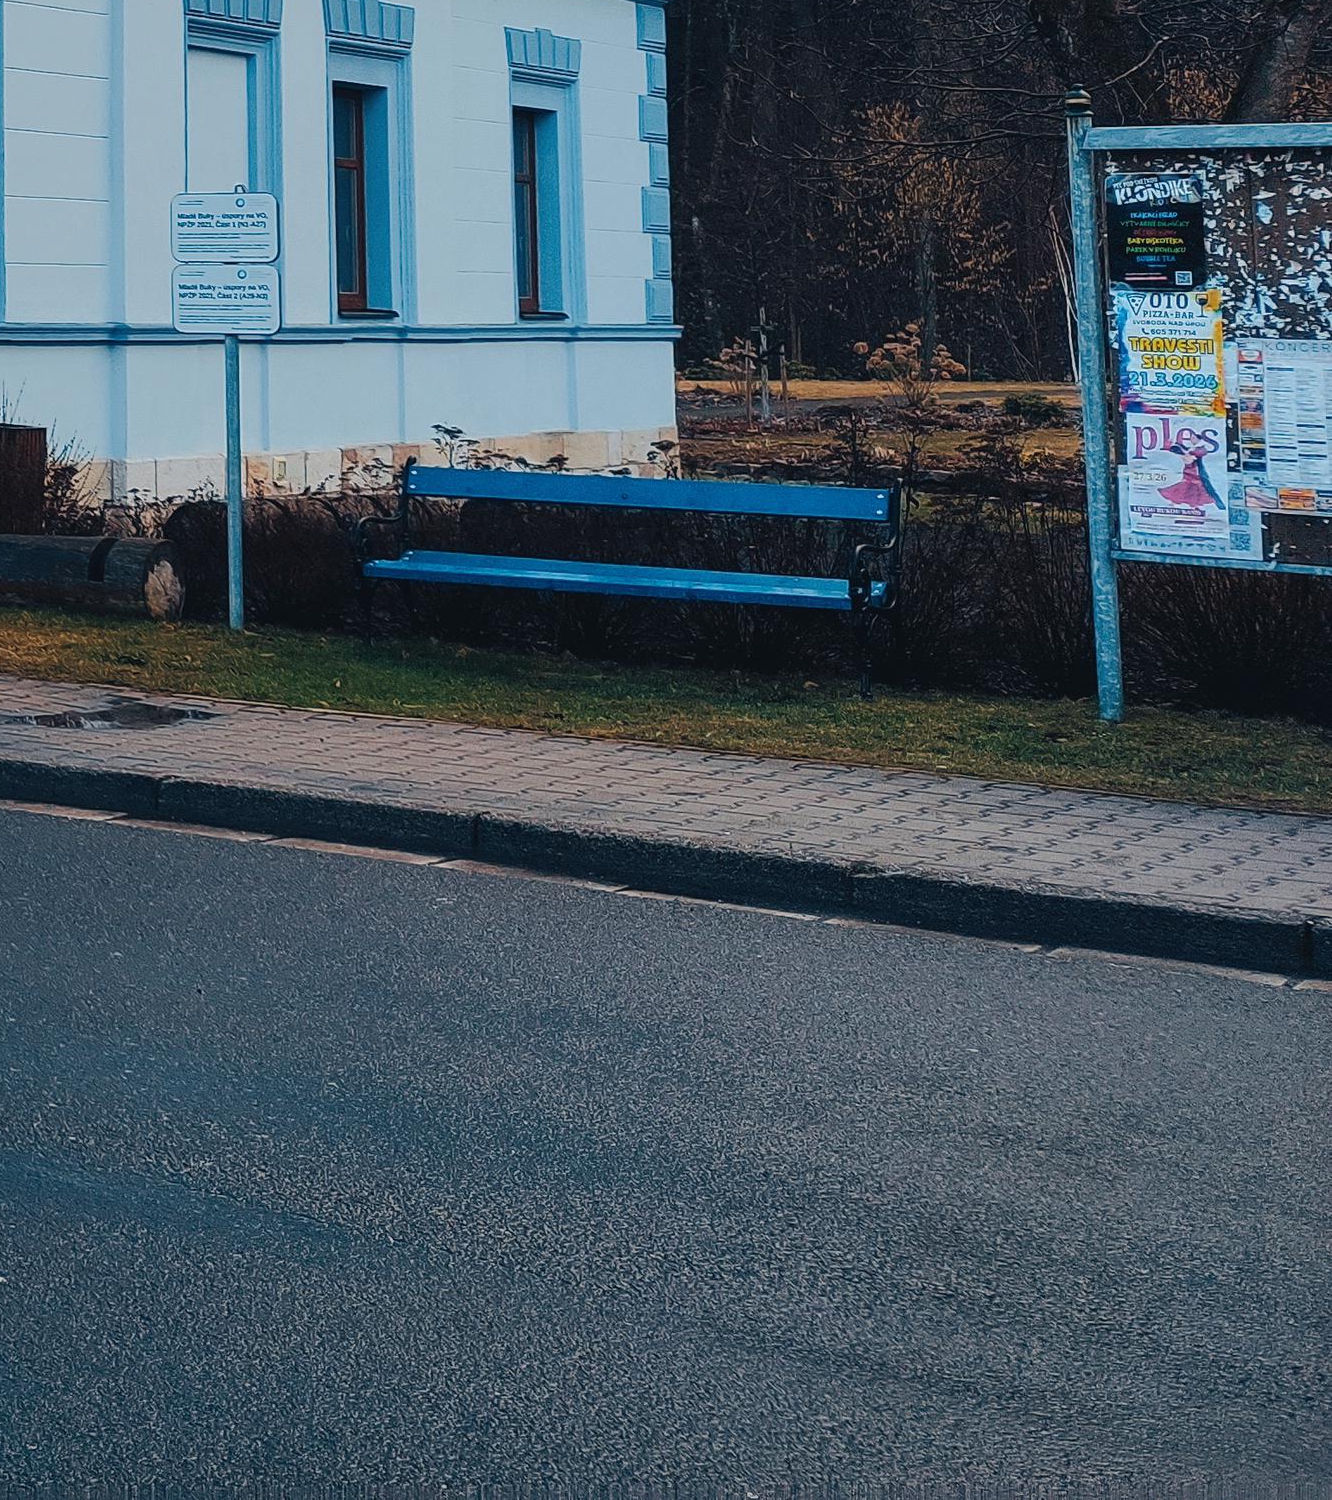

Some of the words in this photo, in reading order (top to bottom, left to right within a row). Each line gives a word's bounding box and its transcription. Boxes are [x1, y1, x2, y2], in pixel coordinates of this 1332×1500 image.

[1115, 179, 1193, 205] KLONDIKE
[1150, 292, 1188, 309] OTO
[1143, 310, 1194, 319] PIZZA-BAR
[1128, 336, 1214, 354] TRAVESTI
[1141, 354, 1201, 371] SHOW
[1129, 371, 1218, 389] 21.3.2026
[1132, 418, 1219, 460] ples
